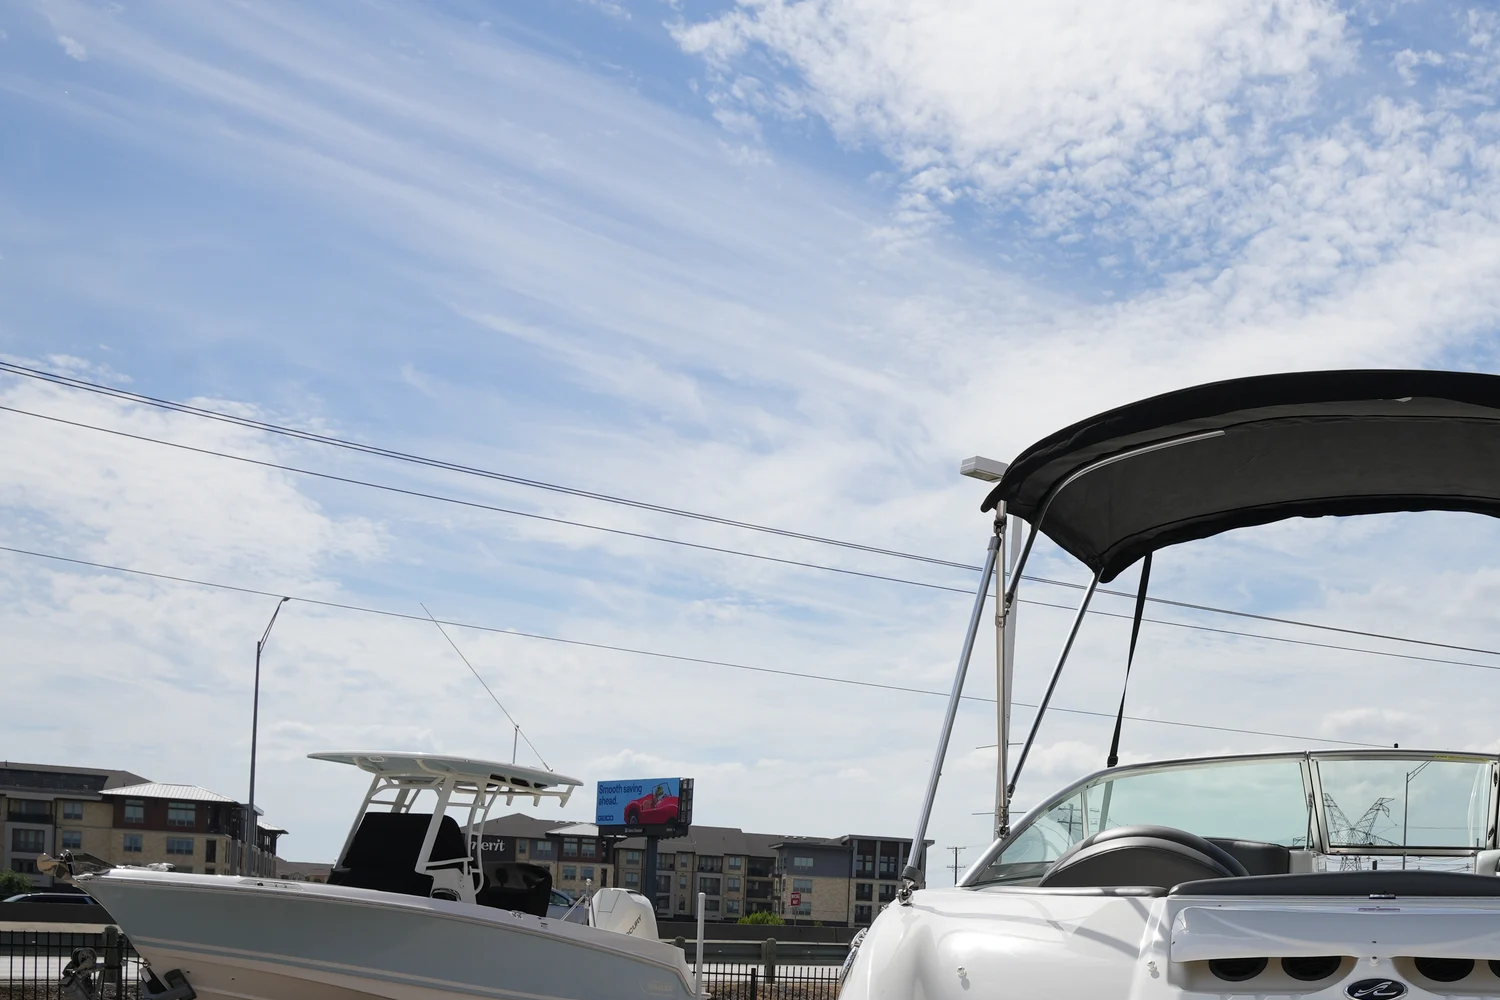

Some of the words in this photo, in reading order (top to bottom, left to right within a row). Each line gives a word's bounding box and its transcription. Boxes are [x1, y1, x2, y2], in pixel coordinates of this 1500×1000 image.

[599, 783, 623, 794] Smooth
[623, 783, 643, 795] saving
[598, 798, 618, 806] ahead.
